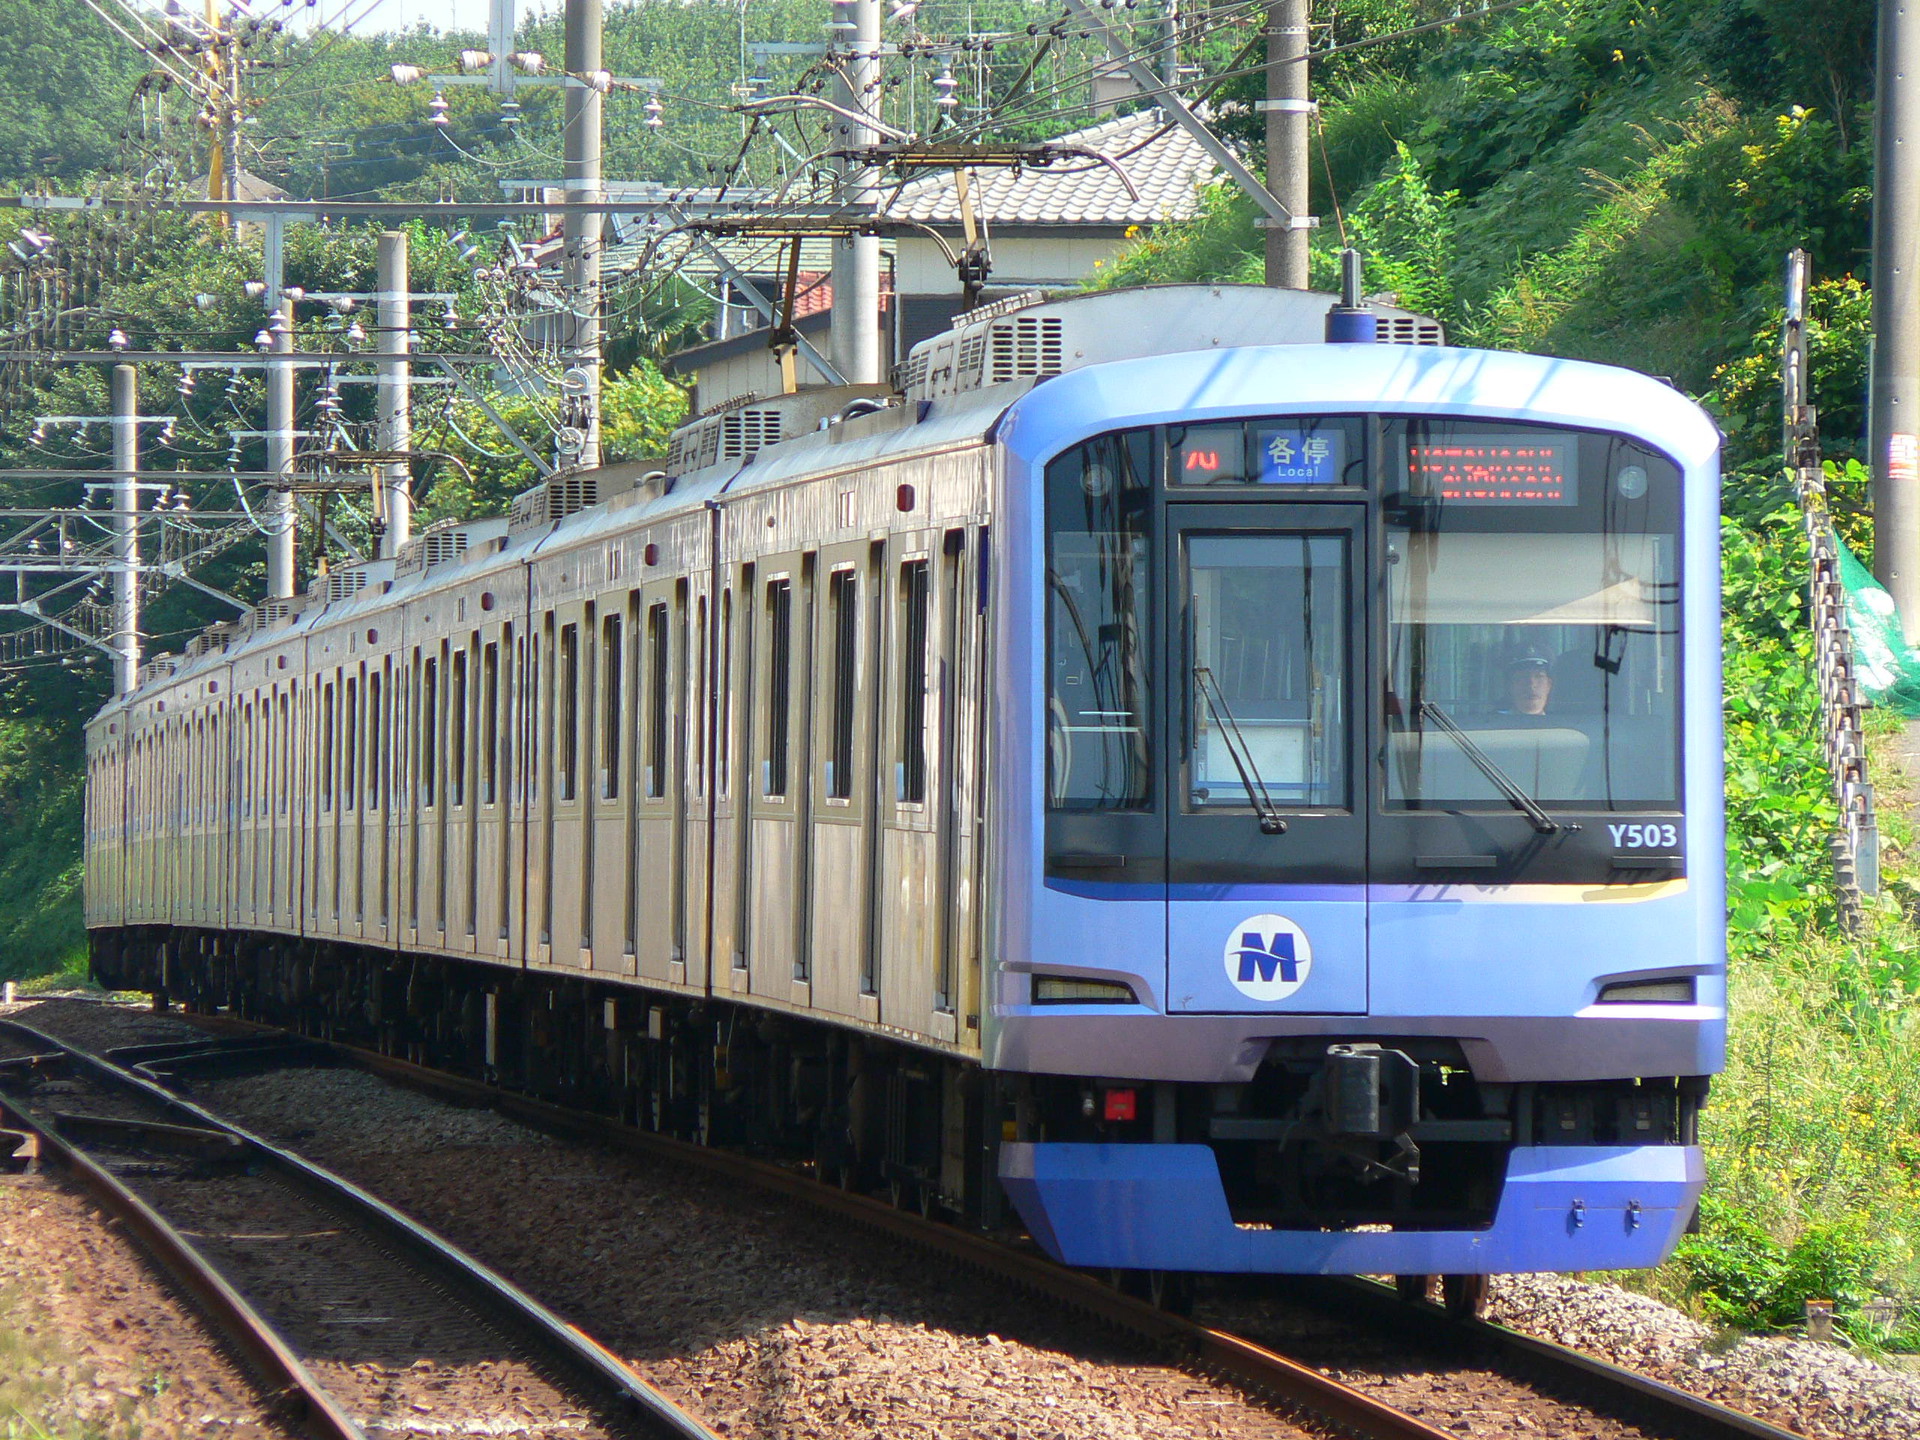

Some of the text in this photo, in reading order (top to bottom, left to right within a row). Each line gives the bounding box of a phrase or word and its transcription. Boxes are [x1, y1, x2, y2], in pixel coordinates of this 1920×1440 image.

[1268, 436, 1329, 465] 各停
[1278, 466, 1319, 477] Local
[1608, 824, 1678, 848] Y503
